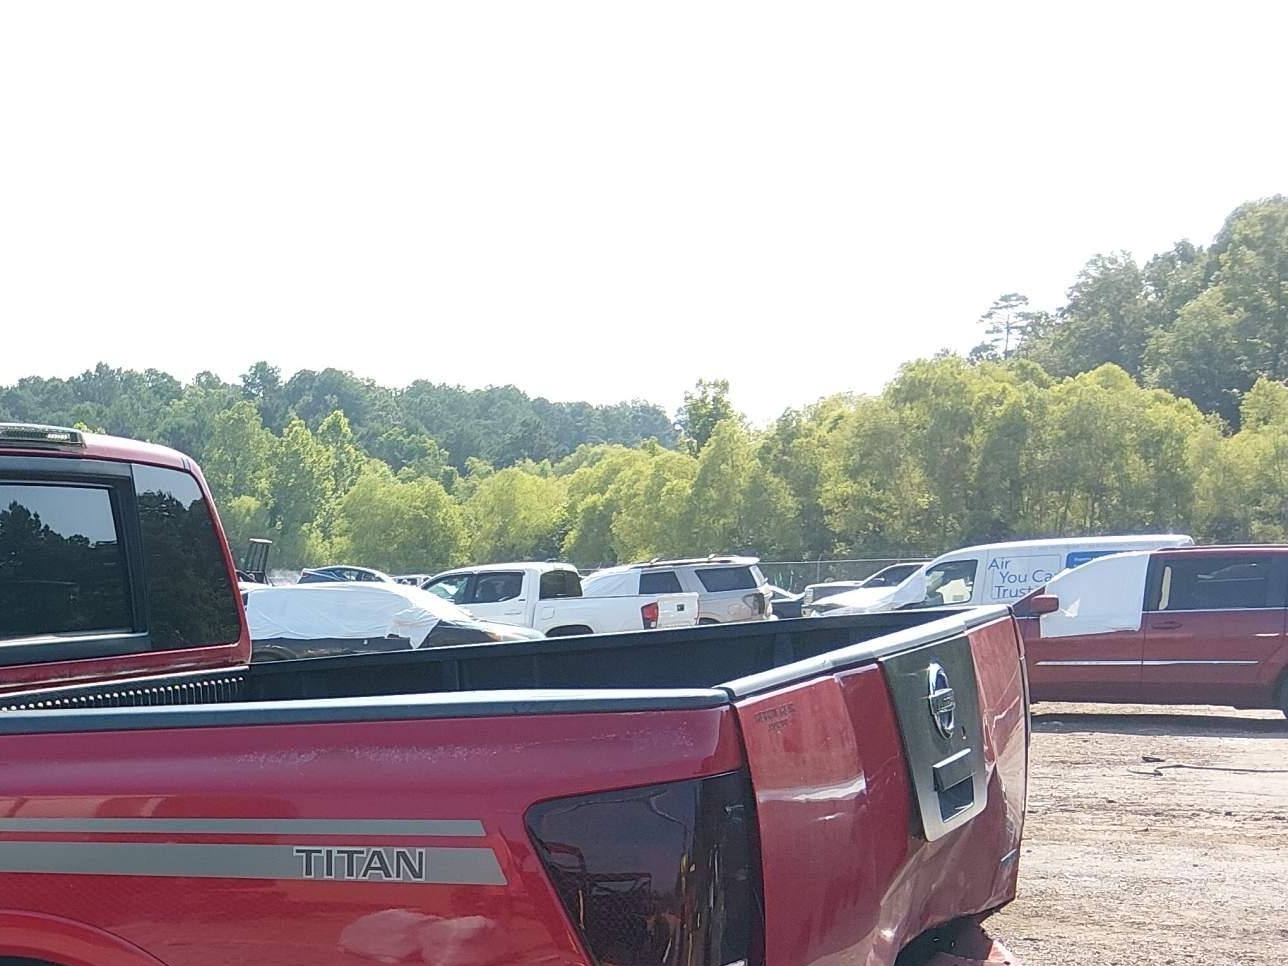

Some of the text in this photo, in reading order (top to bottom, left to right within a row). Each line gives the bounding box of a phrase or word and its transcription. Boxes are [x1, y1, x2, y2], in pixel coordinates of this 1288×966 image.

[988, 558, 1010, 570] Air
[1000, 569, 1057, 584] You Ca
[293, 846, 425, 881] TITAN
